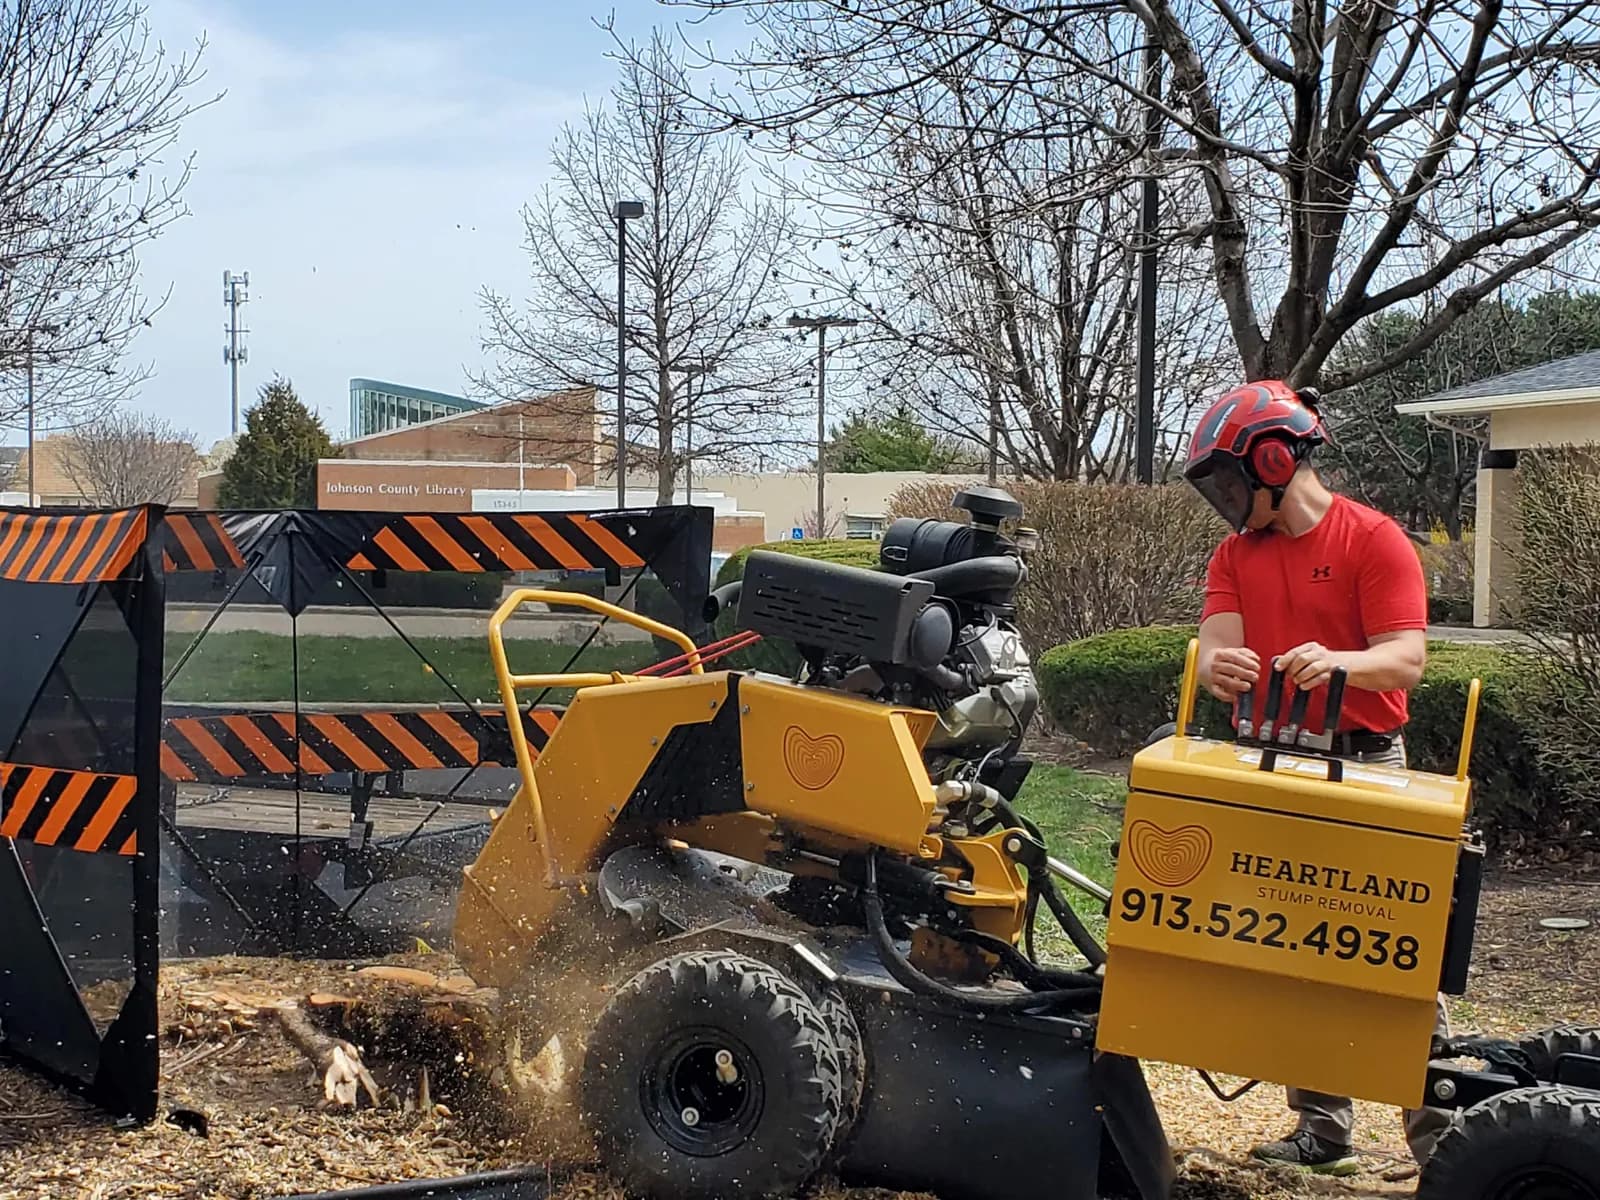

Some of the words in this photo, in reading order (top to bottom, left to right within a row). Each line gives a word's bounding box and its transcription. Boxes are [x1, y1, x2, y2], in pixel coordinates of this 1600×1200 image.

[326, 482, 373, 494] Johnson
[378, 483, 419, 497] County
[426, 484, 467, 497] Library
[1230, 852, 1430, 904] HEARTLAND
[1256, 886, 1314, 905] STUMP
[1318, 897, 1396, 921] REMOVAL
[1120, 888, 1420, 971] 913.522.4938
